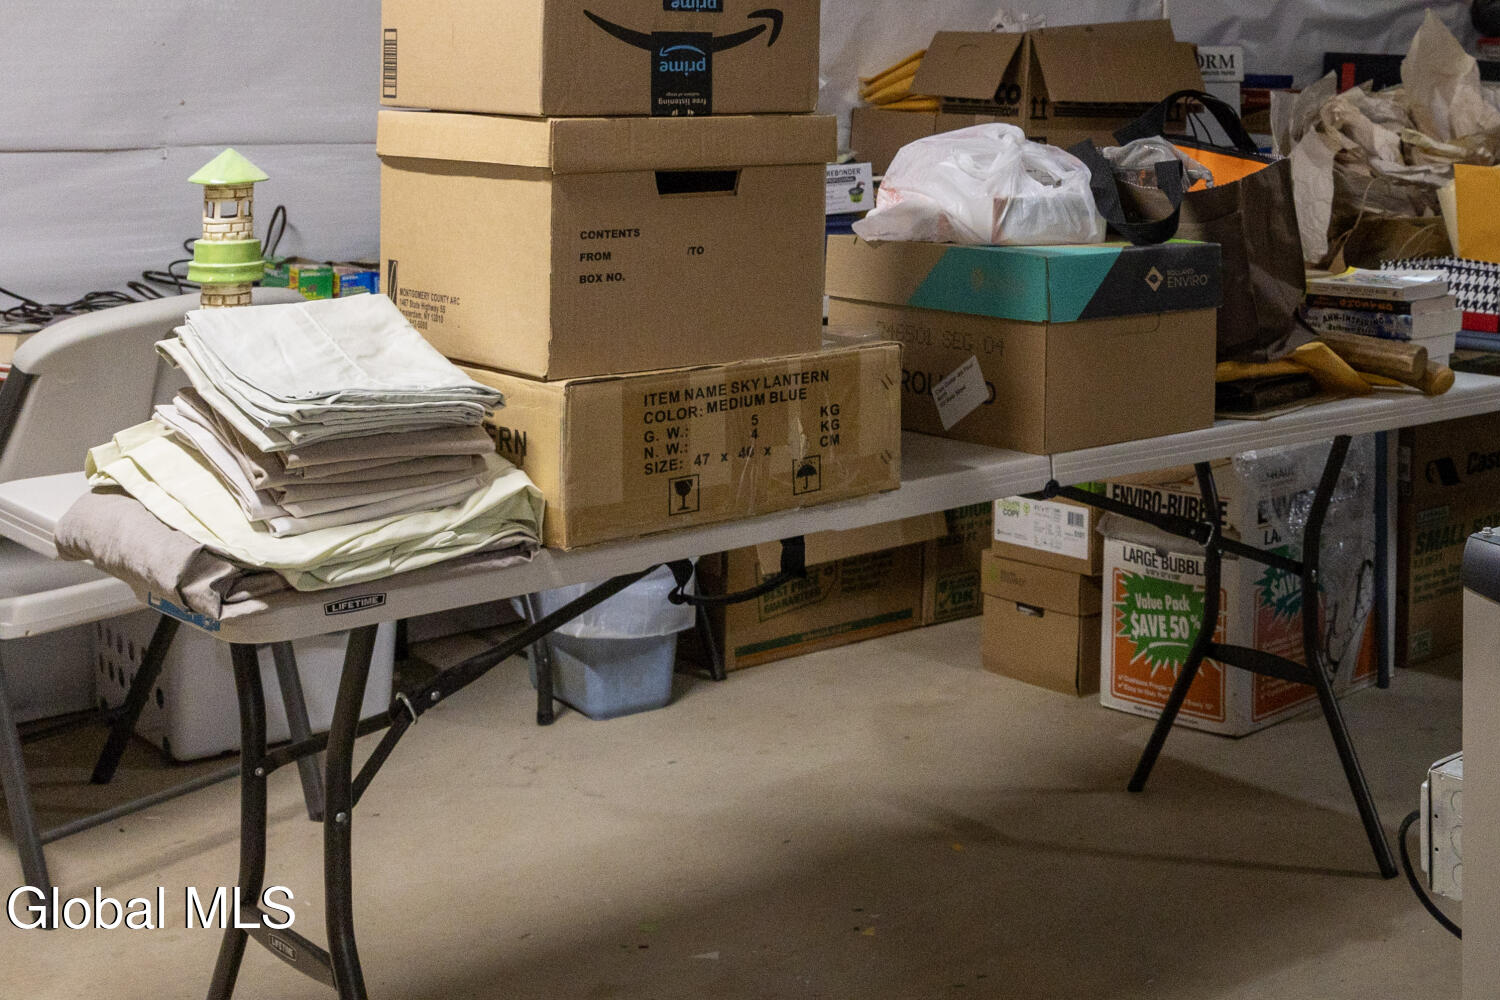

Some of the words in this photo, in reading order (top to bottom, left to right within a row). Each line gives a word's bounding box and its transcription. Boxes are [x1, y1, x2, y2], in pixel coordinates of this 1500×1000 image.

[659, 57, 706, 77] prime
[580, 228, 640, 240] CONTENTS
[580, 252, 611, 261] FROM
[579, 274, 602, 284] BOX
[606, 272, 625, 282] NO.
[1166, 275, 1208, 289] ENVIRO
[400, 288, 430, 300] MONTGOMERY
[431, 293, 450, 304] COUNTY
[644, 390, 680, 408] ITEM
[684, 384, 727, 401] NAME
[731, 378, 760, 394] SKY
[764, 370, 830, 390] LANTERN
[644, 406, 703, 425] COLOR:
[706, 394, 766, 414] MEDIUM
[770, 388, 807, 404] BLUE
[751, 414, 759, 426] 5
[820, 404, 840, 417] KG
[751, 428, 758, 439] 4
[820, 419, 840, 432] KG
[644, 459, 684, 476] SIZE:
[694, 453, 710, 466] 47
[820, 434, 840, 447] CM
[1123, 545, 1158, 569] LARGE
[1161, 555, 1205, 577] BUBBL
[331, 596, 379, 612] LIFETIME
[1134, 593, 1163, 610] Value
[1165, 595, 1191, 612] Pack
